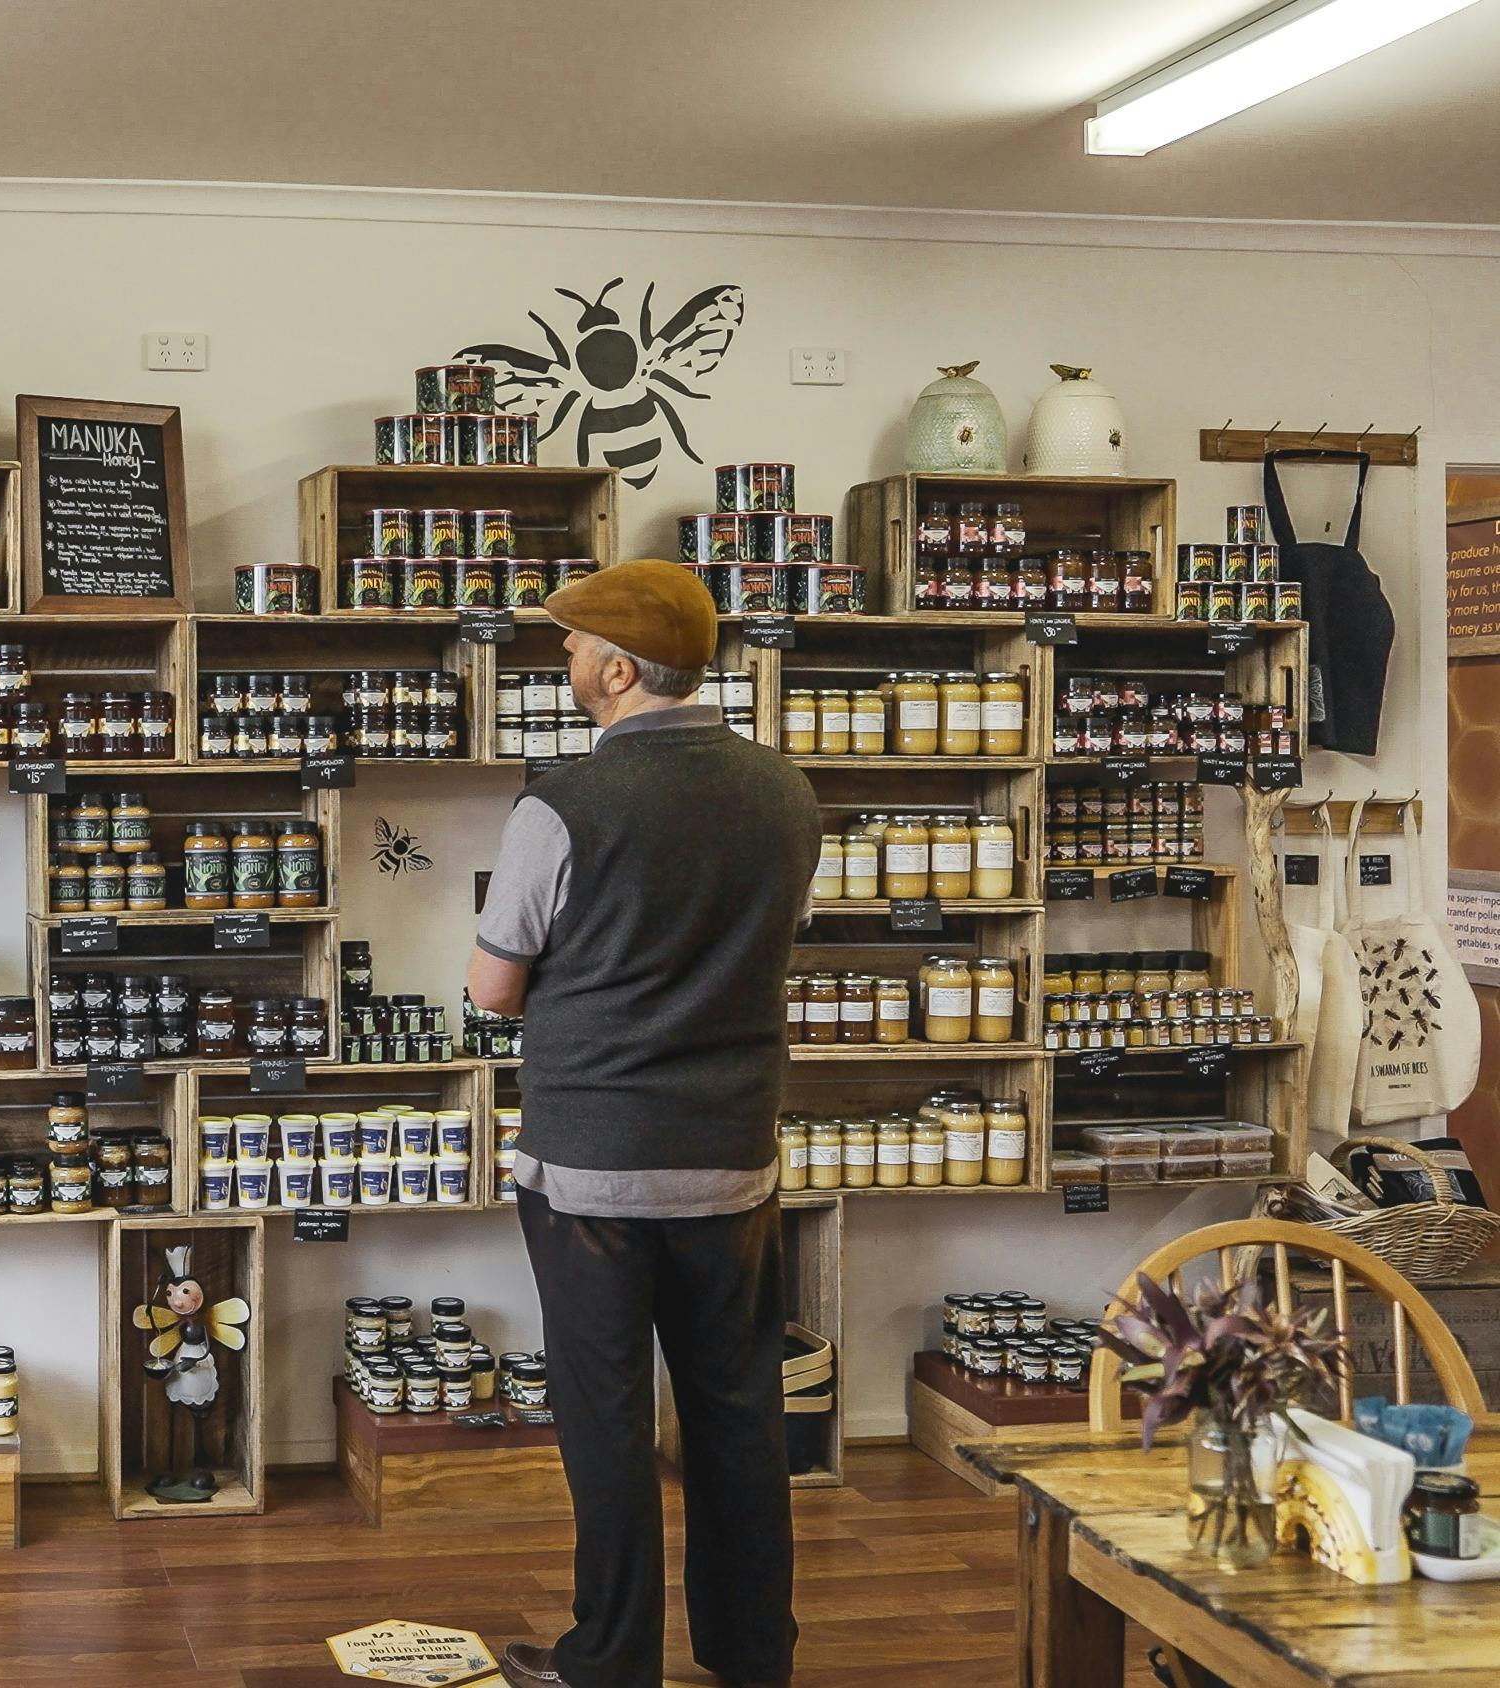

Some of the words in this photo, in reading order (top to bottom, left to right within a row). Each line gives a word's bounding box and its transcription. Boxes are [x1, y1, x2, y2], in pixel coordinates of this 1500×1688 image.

[51, 423, 145, 456] MANUKA
[102, 452, 141, 479] Honey
[1451, 546, 1490, 563] produce
[515, 578, 543, 590] HONEY
[1460, 584, 1474, 597] for
[1454, 605, 1480, 616] more
[1449, 623, 1479, 637] honey
[1482, 623, 1493, 633] as
[15, 763, 56, 771] LEATHERWOOD
[199, 863, 227, 874] HONEY
[238, 862, 268, 873] HONEY
[288, 861, 317, 872] HONEY
[1447, 907, 1476, 918] transfer
[1455, 923, 1469, 932] and
[1484, 956, 1499, 965] one
[1371, 1065, 1376, 1078] A
[1375, 1063, 1401, 1077] SWARM
[1402, 1062, 1410, 1075] OF
[1412, 1061, 1429, 1075] BEES
[411, 1629, 432, 1638] all
[368, 1645, 451, 1656] pollination
[368, 1653, 463, 1663] HONEYBEES
